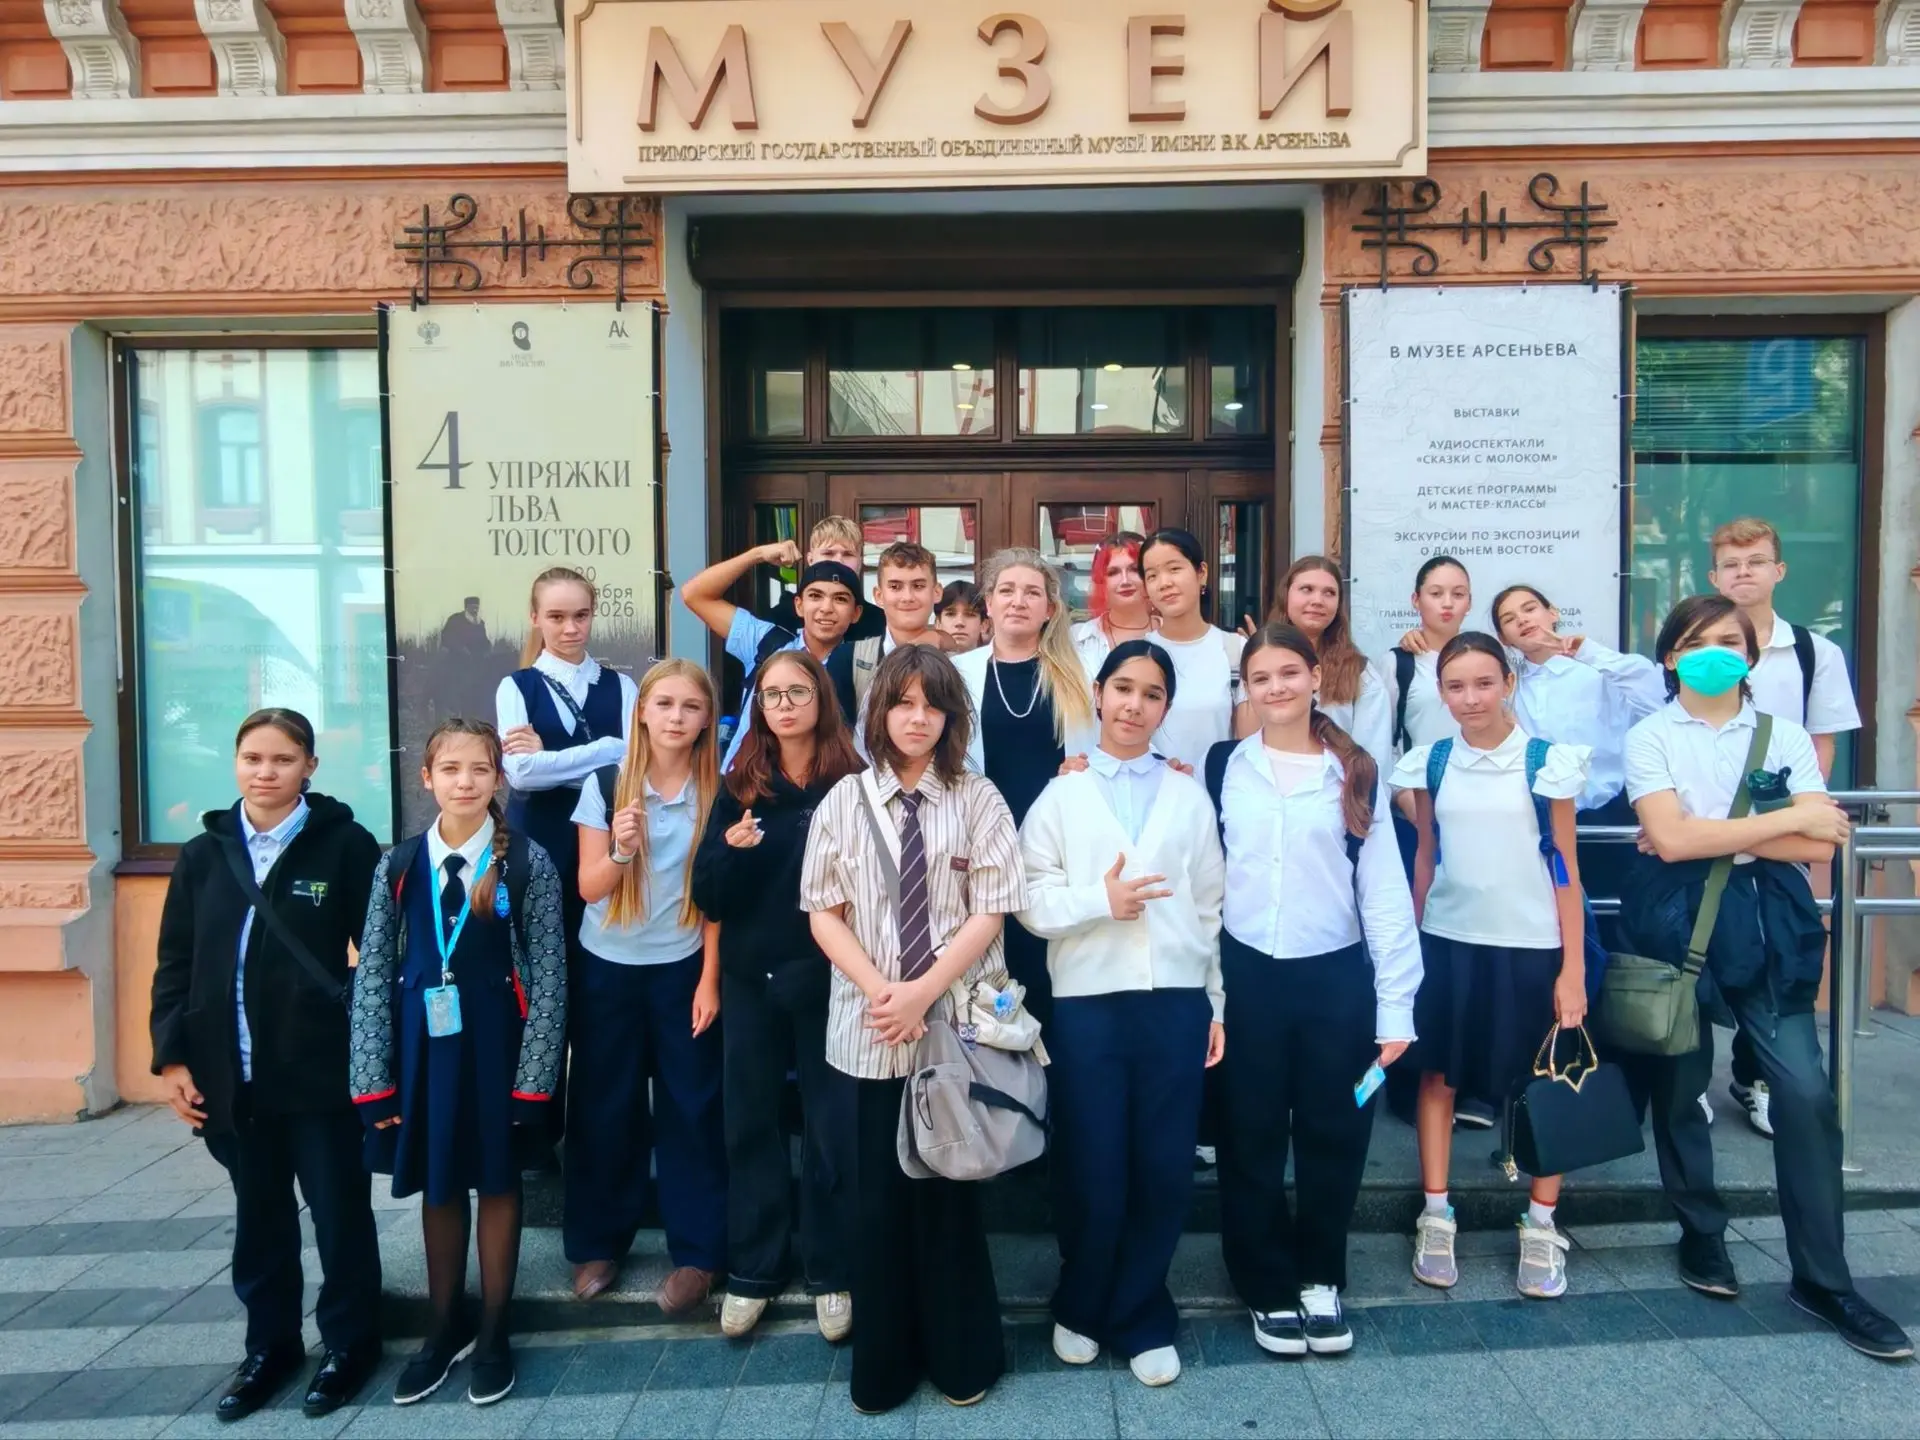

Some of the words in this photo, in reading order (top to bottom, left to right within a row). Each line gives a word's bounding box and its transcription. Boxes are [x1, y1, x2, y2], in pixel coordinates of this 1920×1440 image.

[637, 0, 1353, 132] МУЗЕЙ
[638, 142, 756, 162] ПРИМОРСКИЙ
[760, 138, 936, 160] ГОСУДАРСТВЕННЫЙ
[941, 134, 1083, 157] ОБЪЕДИНЕННЫЙ
[1088, 134, 1147, 154] МУЗЕЙ
[1151, 134, 1216, 152] ИМЕНИ
[1254, 131, 1352, 150] АРСЕНЬЕВА
[1390, 346, 1400, 358] В
[1407, 345, 1466, 358] МУЗЕЕ
[1472, 343, 1578, 357] АРСЕНЬЕВА
[1454, 408, 1520, 418] ВЫСТАВКИ
[416, 411, 473, 490] 4
[1429, 439, 1545, 450] АУДИОСПЕКТАКЛИ
[1416, 454, 1470, 464] «СКАЗКИ
[1475, 454, 1482, 463] С
[1486, 453, 1558, 463] МОЛОКОМ»
[487, 460, 631, 490] УПРЯЖКИ
[1417, 486, 1473, 497] ДЕТСКИЕ
[1477, 484, 1557, 495] ПРОГРАММЫ
[487, 495, 561, 523] ЛЬВА
[1429, 501, 1437, 510] И
[1442, 499, 1546, 510] МАСТЕР-КЛАССЫ
[488, 528, 632, 556] ТОЛСТОГО
[1394, 531, 1467, 542] ЭКСКУРСИИ
[1471, 531, 1489, 541] ПО
[1494, 529, 1580, 541] ЭКСПОЗИЦИИ
[1420, 546, 1429, 556] О
[1433, 546, 1493, 557] ДАЛЬНЕМ
[1497, 544, 1554, 555] ВОСТОКЕ
